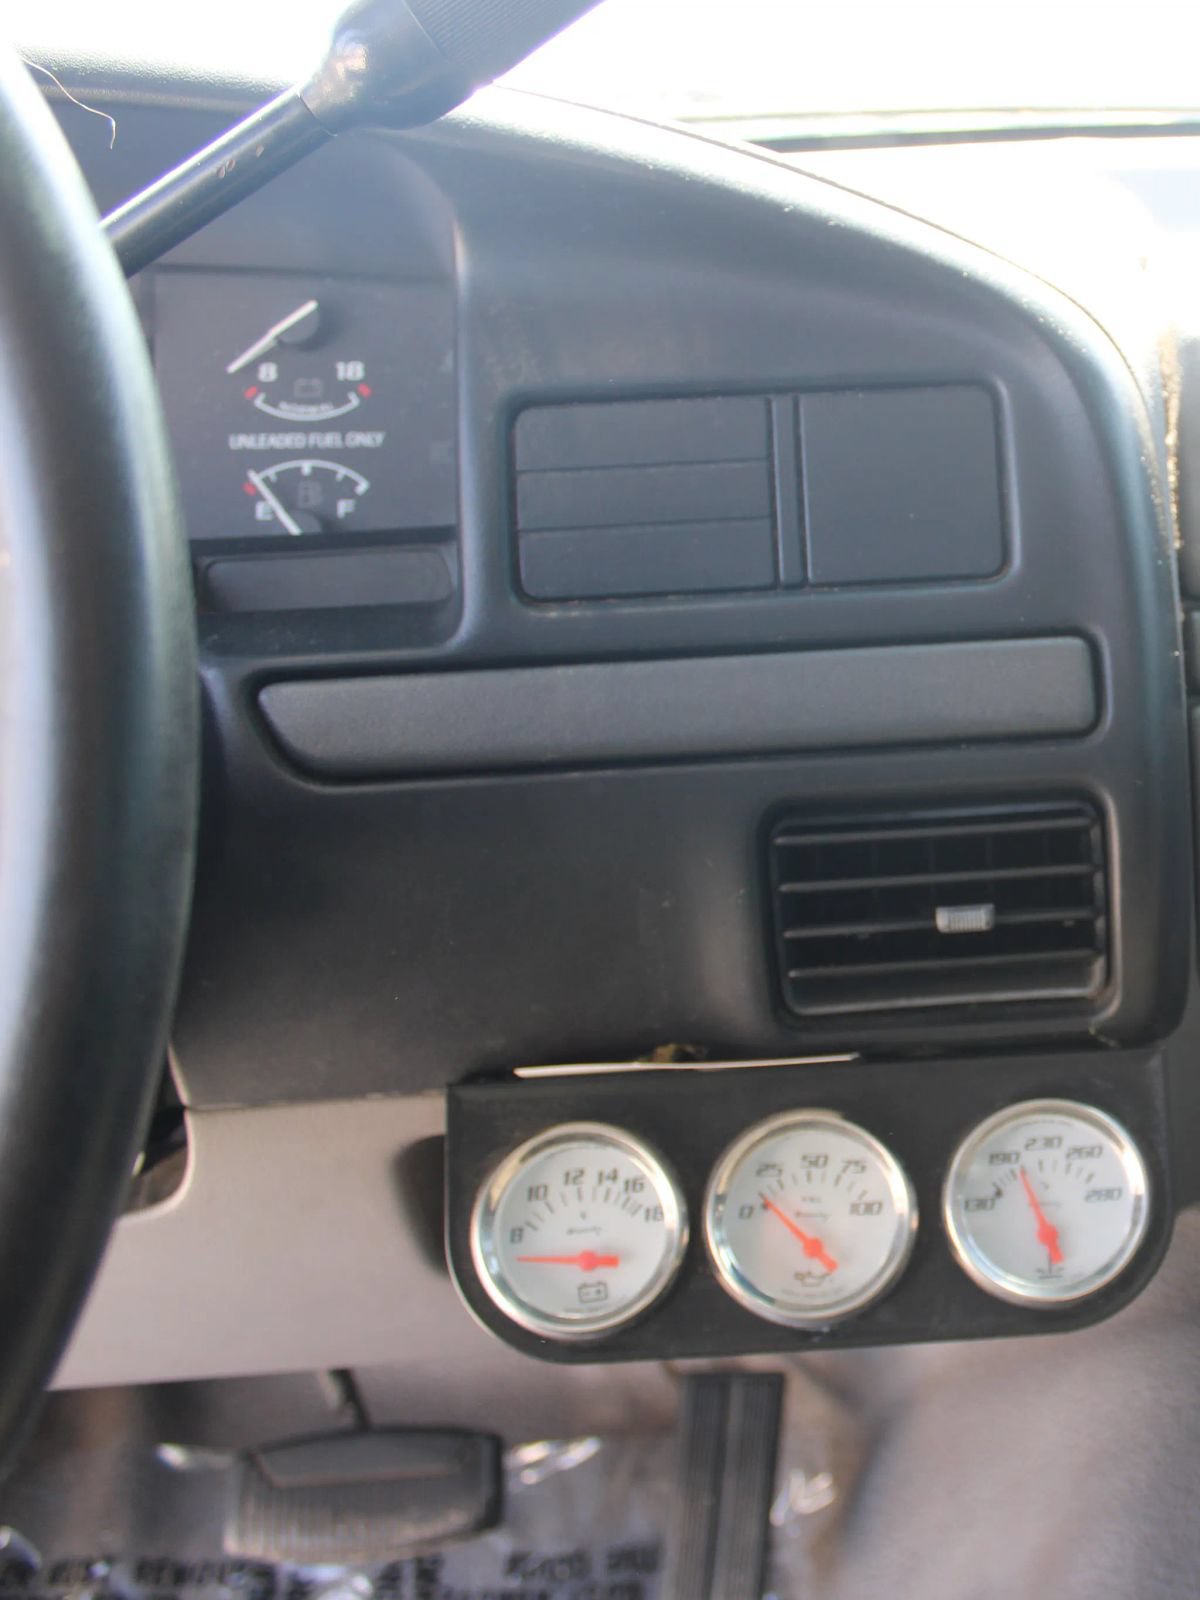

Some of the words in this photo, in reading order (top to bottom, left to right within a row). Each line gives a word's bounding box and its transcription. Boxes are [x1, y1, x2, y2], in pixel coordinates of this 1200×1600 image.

[258, 362, 278, 382] 8
[335, 360, 365, 381] 18
[228, 433, 307, 450] UNLEADED
[308, 432, 343, 449] FUEL
[345, 431, 386, 448] ONLY
[255, 500, 273, 521] E
[336, 499, 355, 518] F
[1024, 1135, 1064, 1151] 230
[799, 1153, 829, 1170] 50
[988, 1152, 1021, 1166] 190
[1065, 1145, 1104, 1161] 260
[597, 1167, 619, 1185] 14
[755, 1162, 784, 1178] 25
[840, 1159, 868, 1175] 75
[562, 1167, 585, 1187] 12
[624, 1177, 645, 1194] 16
[527, 1184, 549, 1202] 10
[644, 1204, 665, 1223] 18
[850, 1201, 883, 1217] 100
[964, 1197, 997, 1212] 130
[509, 1226, 525, 1244] 8
